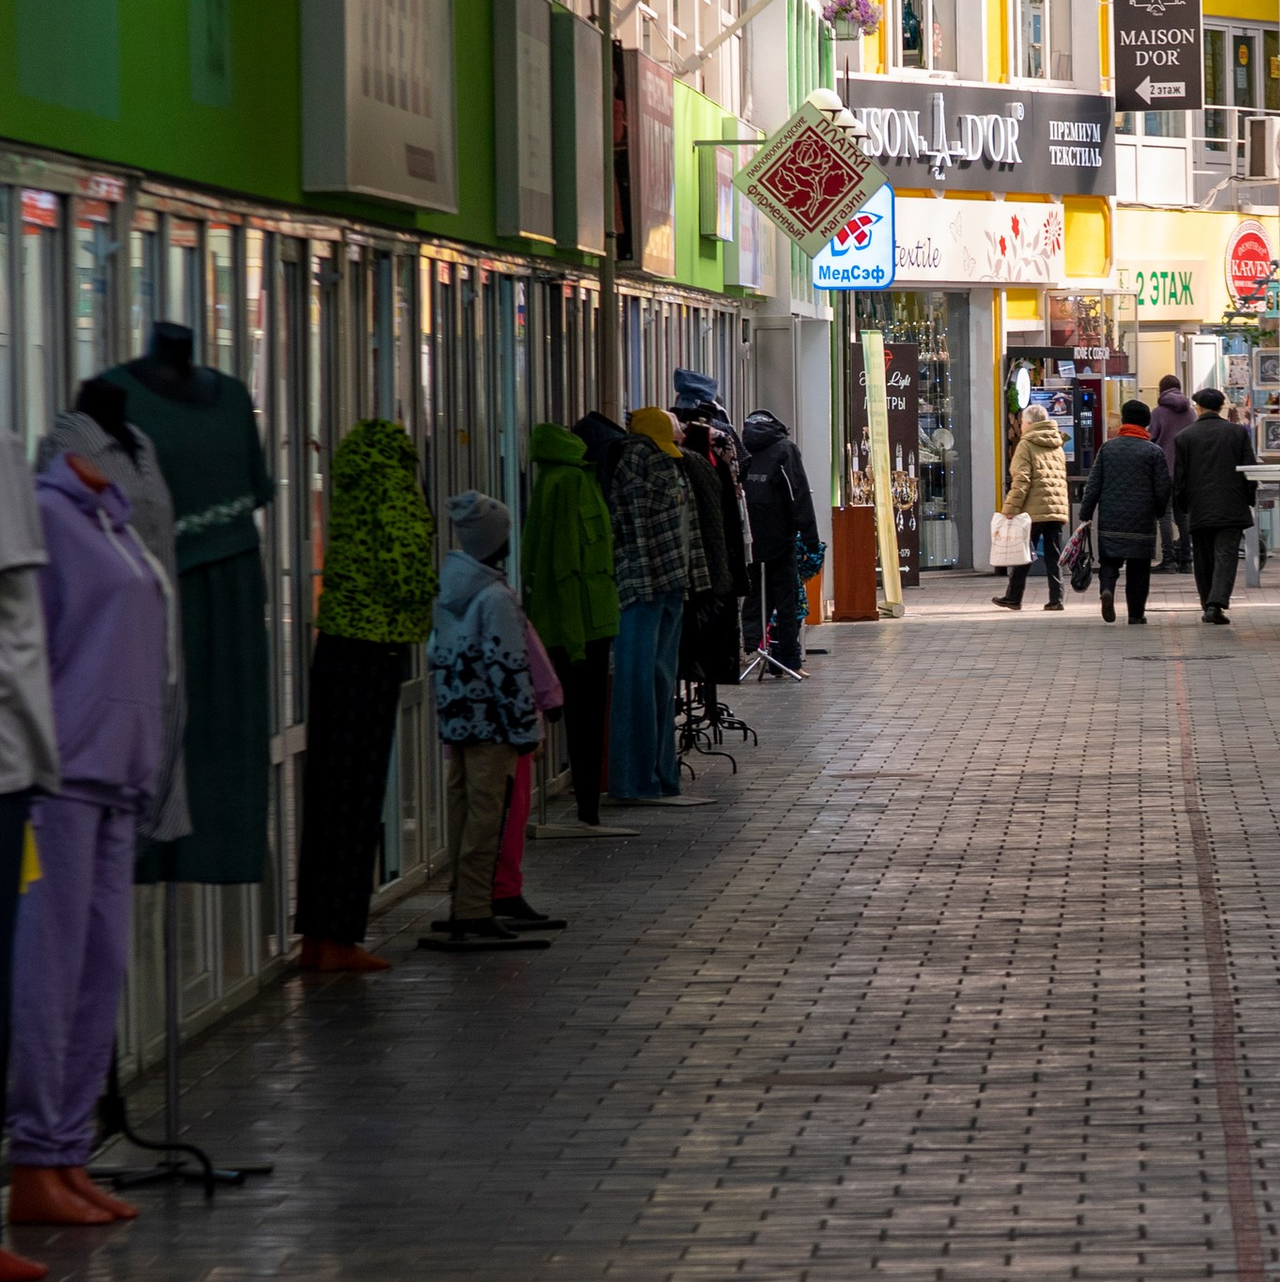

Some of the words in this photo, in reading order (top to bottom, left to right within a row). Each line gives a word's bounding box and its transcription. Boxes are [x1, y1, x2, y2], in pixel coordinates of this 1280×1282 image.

[1119, 28, 1195, 46] MAISON
[1150, 84, 1155, 95] 2
[1157, 85, 1182, 95] этаж
[857, 107, 920, 159] ISON
[1049, 120, 1101, 143] ПРЕМИУМ
[746, 115, 808, 179] ПАВЛОВОПОСАДСКИЕ
[815, 118, 871, 173] ПЛАТКИ
[1049, 145, 1102, 167] ТЕКСТИЛЬ
[820, 189, 867, 238] магазин
[819, 265, 885, 283] МедСэф
[1136, 271, 1145, 306] 2
[1150, 271, 1194, 306] ЭТАЖ
[863, 396, 906, 410] ЛТРЫ
